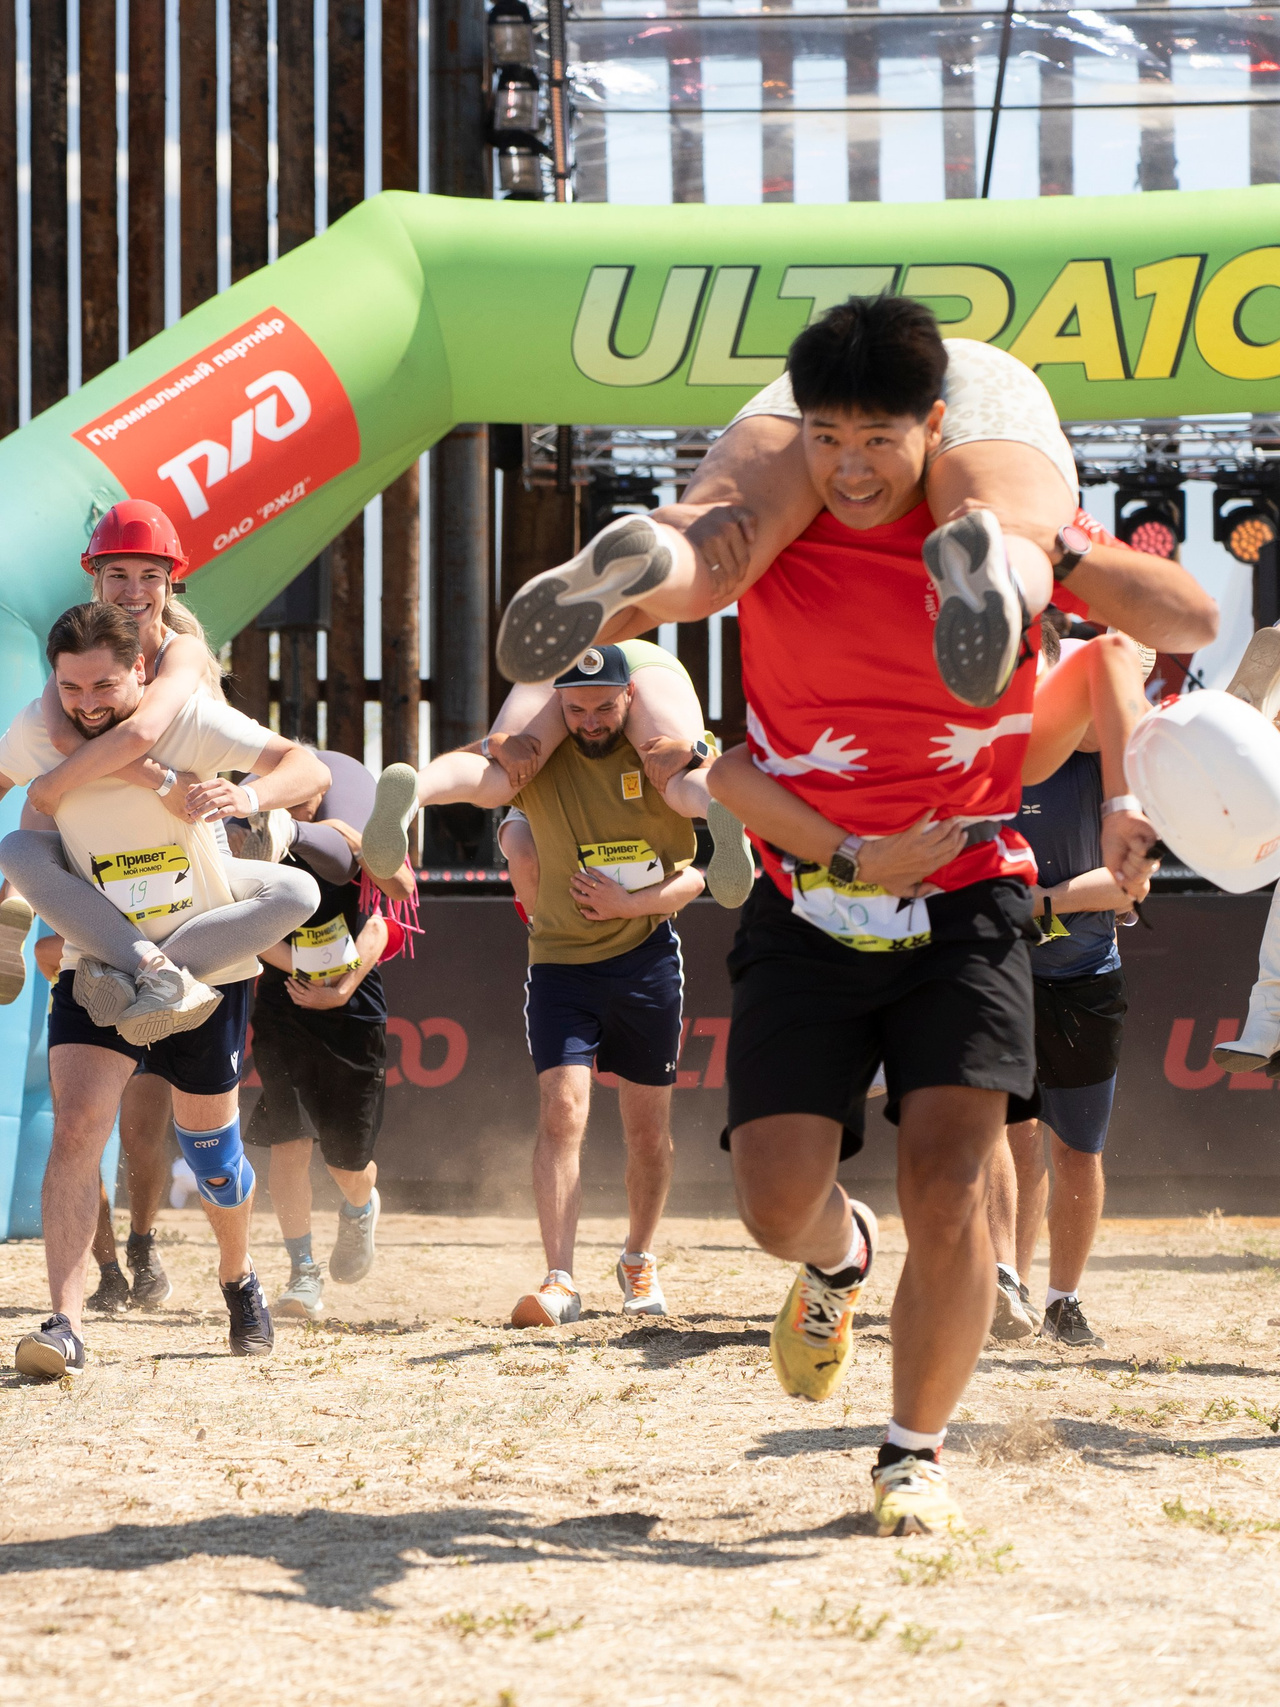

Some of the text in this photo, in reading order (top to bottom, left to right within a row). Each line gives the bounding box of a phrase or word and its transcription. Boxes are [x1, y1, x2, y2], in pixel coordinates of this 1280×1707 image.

[86, 317, 286, 446] Премиальный партнёр
[212, 517, 254, 551] ОАО
[597, 845, 639, 857] Привет
[616, 854, 637, 862] номер
[115, 851, 167, 869] Привет
[123, 864, 162, 876] мой номер
[129, 880, 148, 908] 19
[306, 923, 338, 940] Привет
